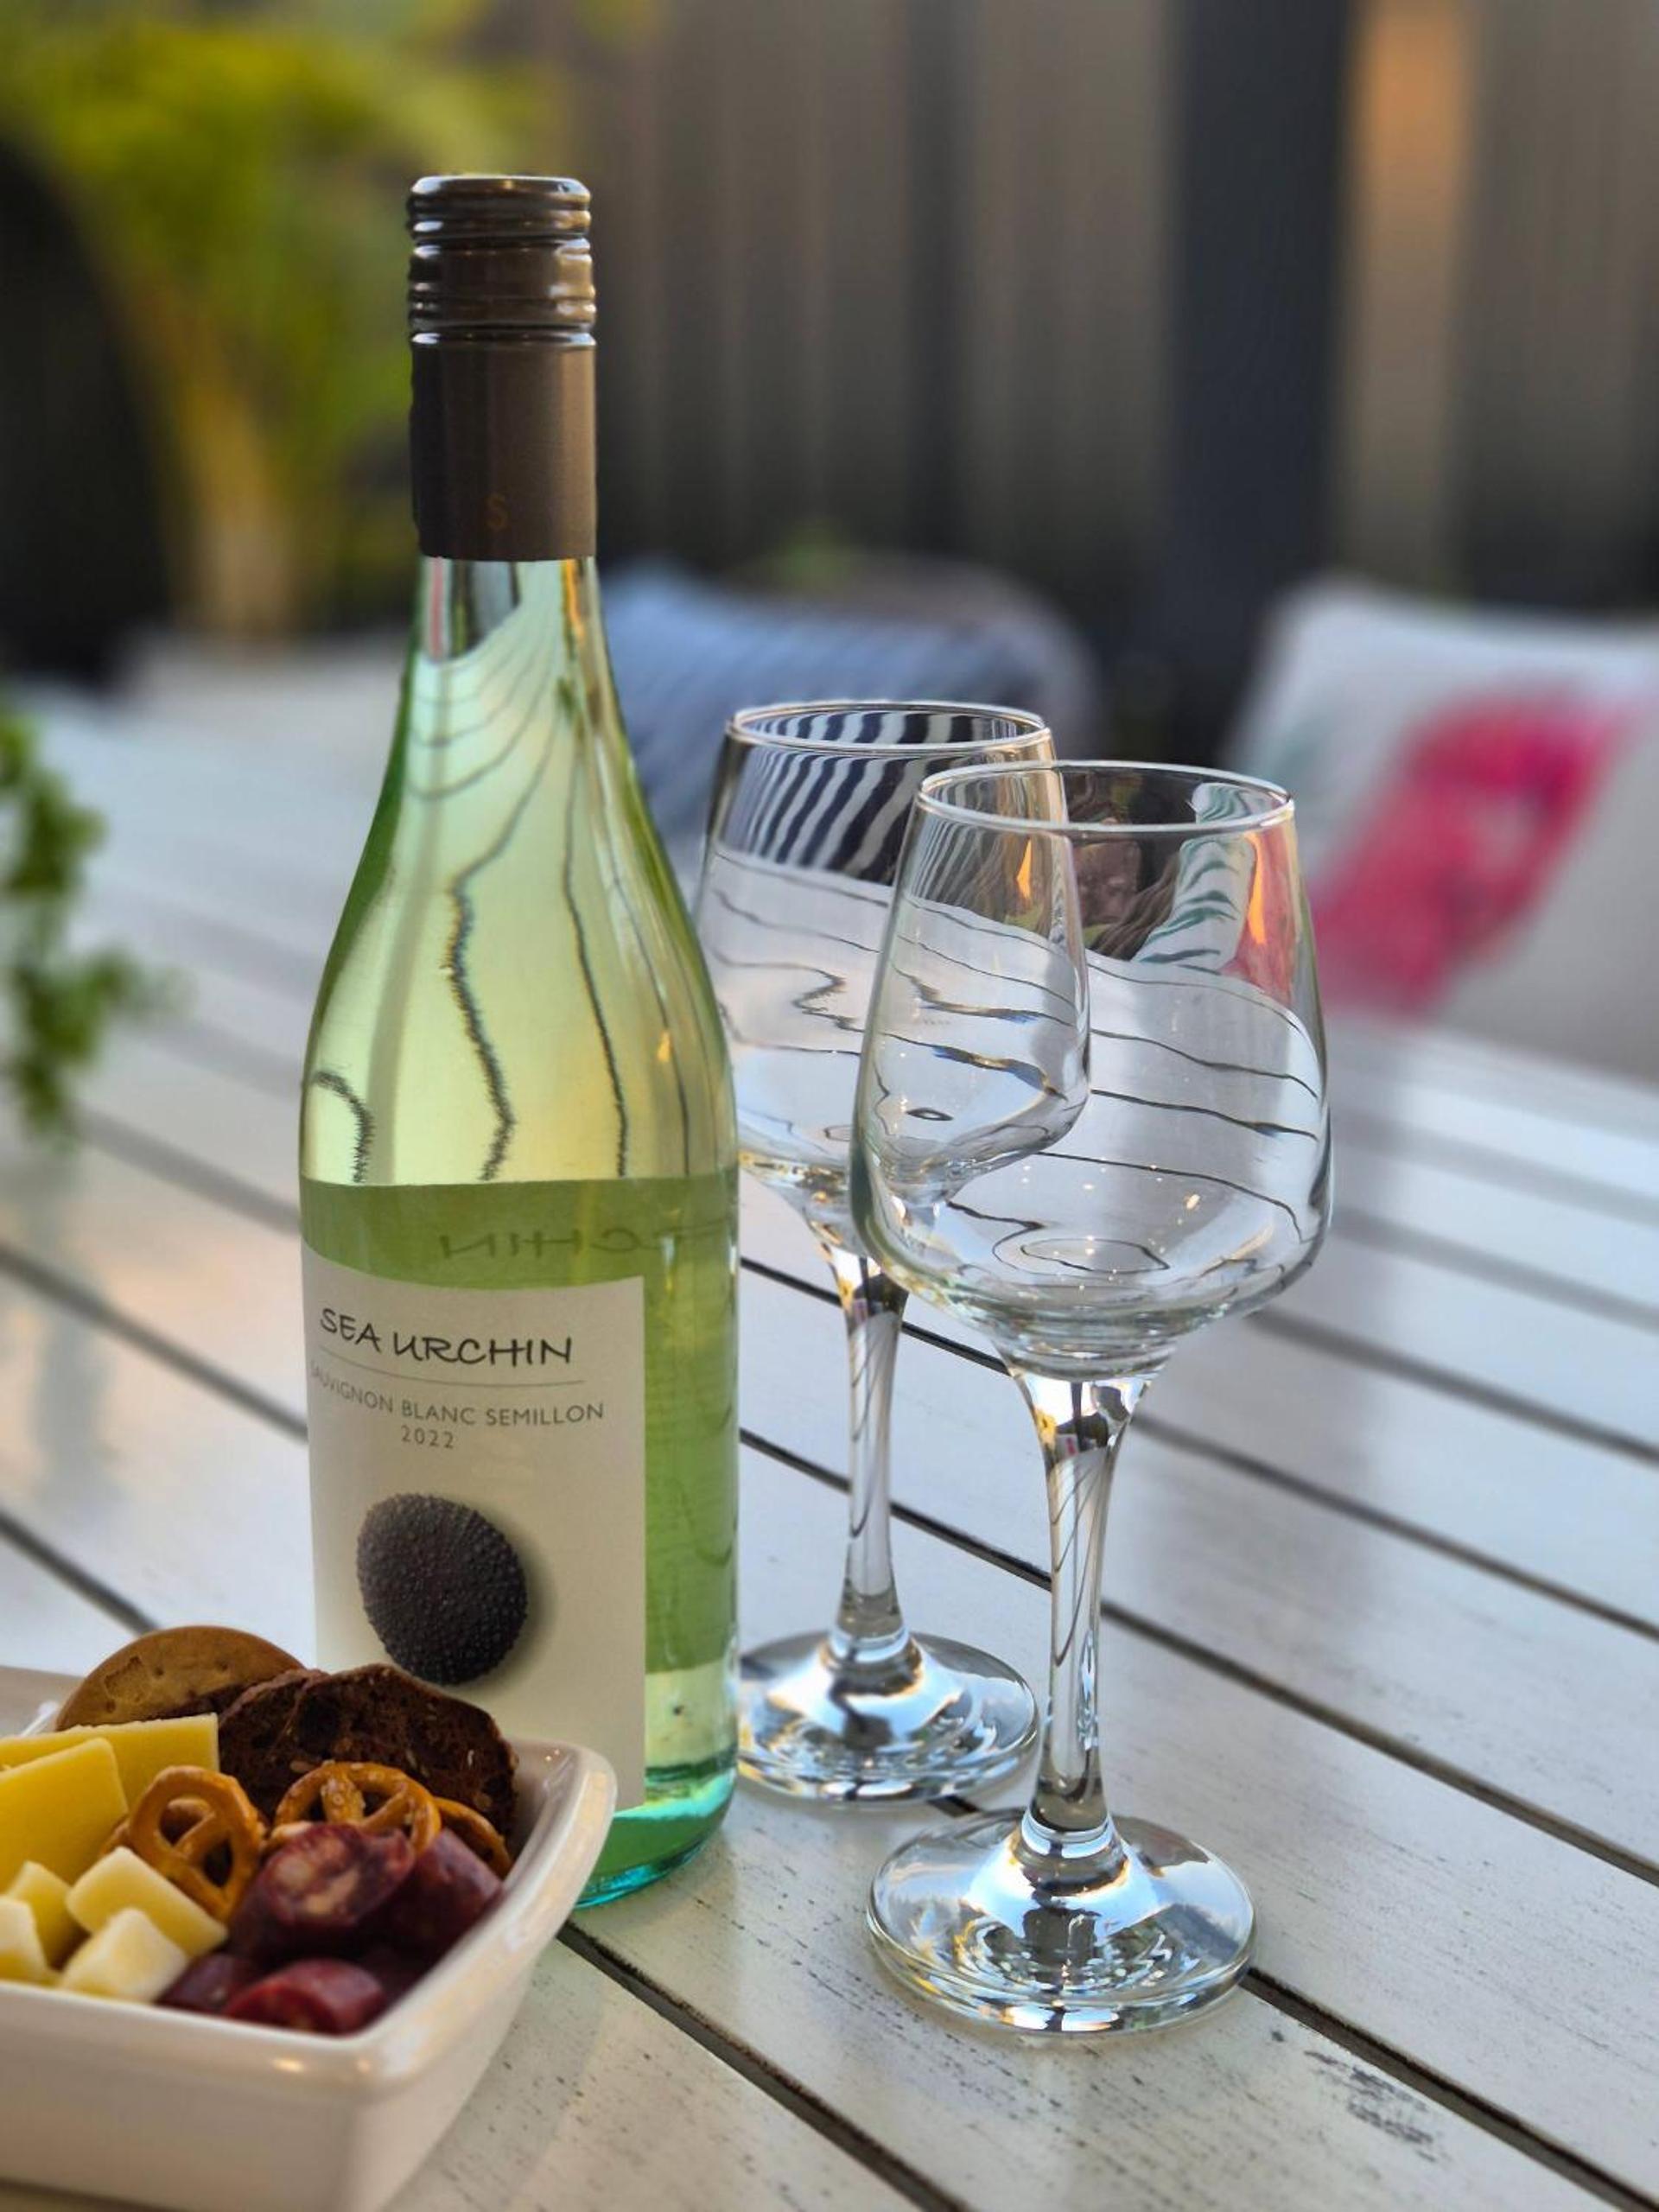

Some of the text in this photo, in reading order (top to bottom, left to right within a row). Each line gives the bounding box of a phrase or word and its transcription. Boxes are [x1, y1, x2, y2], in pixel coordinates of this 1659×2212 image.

[320, 1308, 572, 1367] SEA URCHIN
[402, 1400, 476, 1425] BLANC
[486, 1395, 604, 1427] SEMILLON
[401, 1424, 454, 1450] 2022
